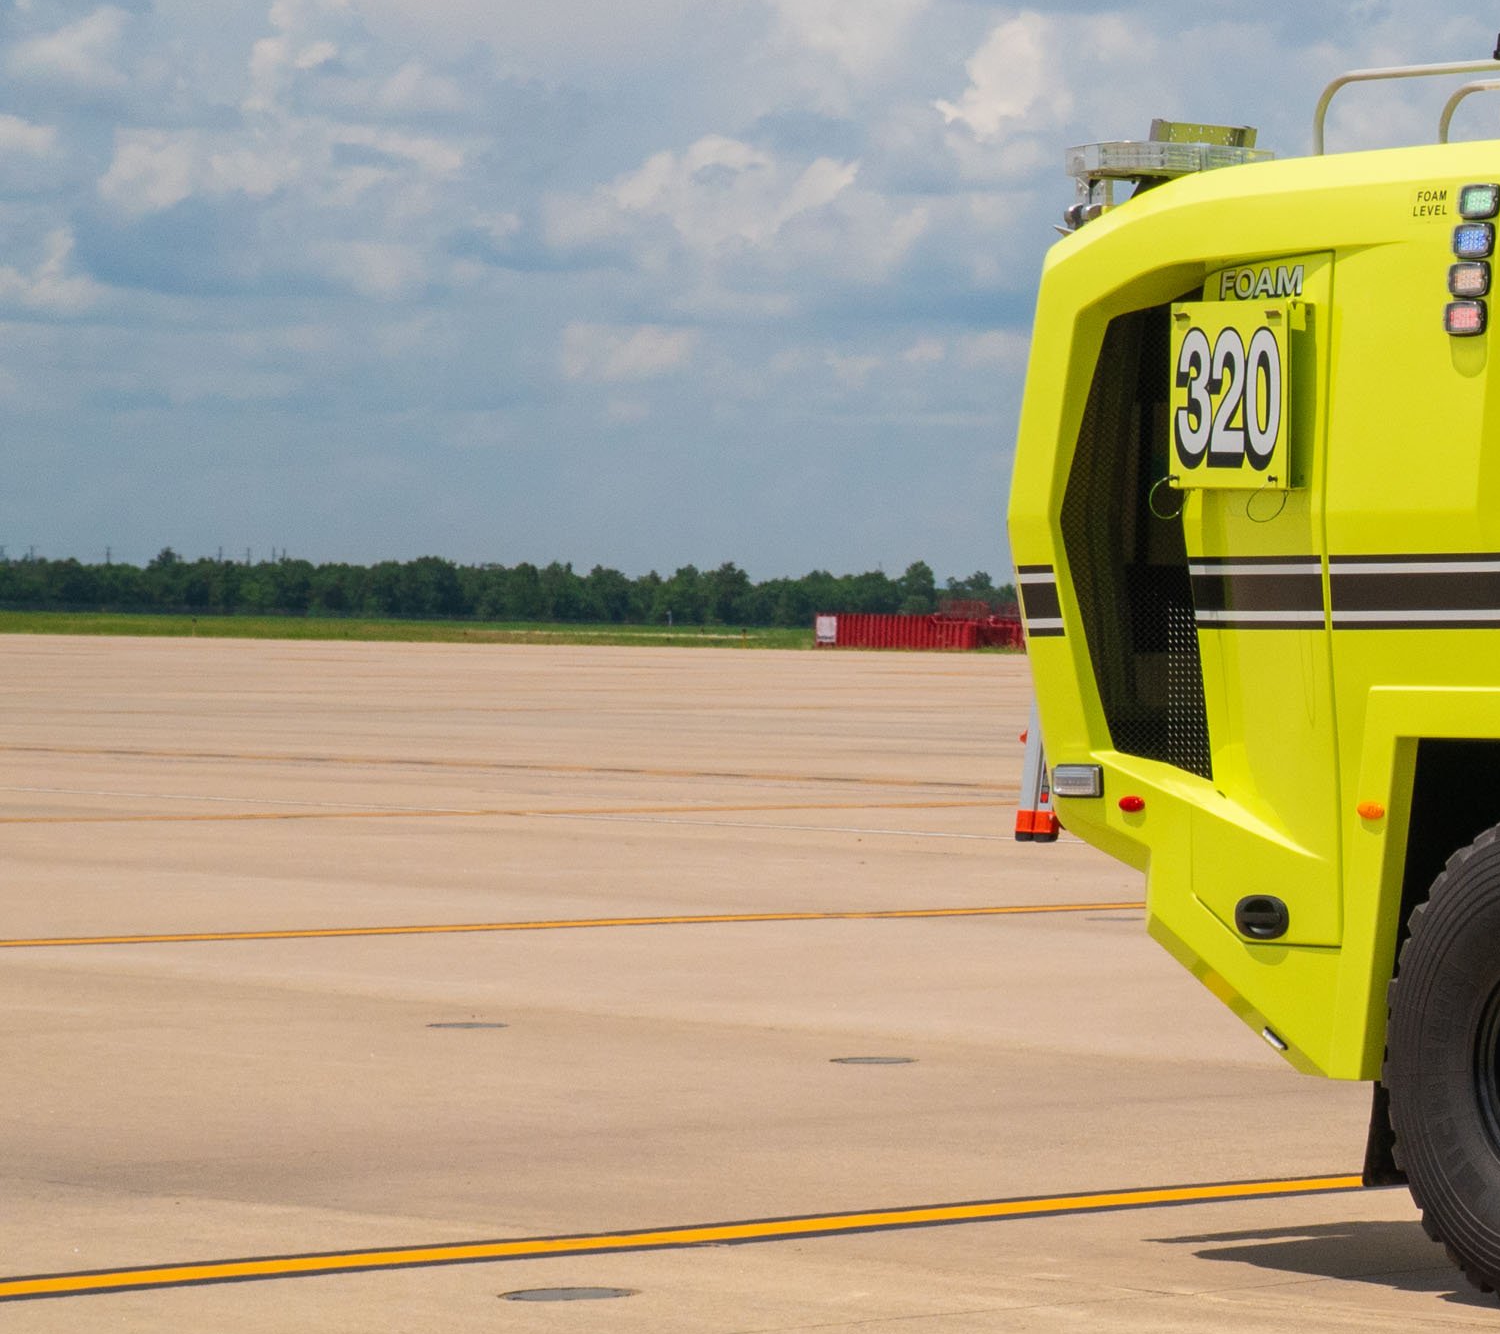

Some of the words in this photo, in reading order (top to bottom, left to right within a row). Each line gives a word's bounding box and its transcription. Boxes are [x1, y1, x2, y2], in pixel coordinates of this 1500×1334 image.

[1417, 190, 1447, 203] FOAM
[1412, 204, 1448, 217] LEVEL
[1219, 264, 1304, 301] FOAM
[1174, 326, 1283, 470] 320
